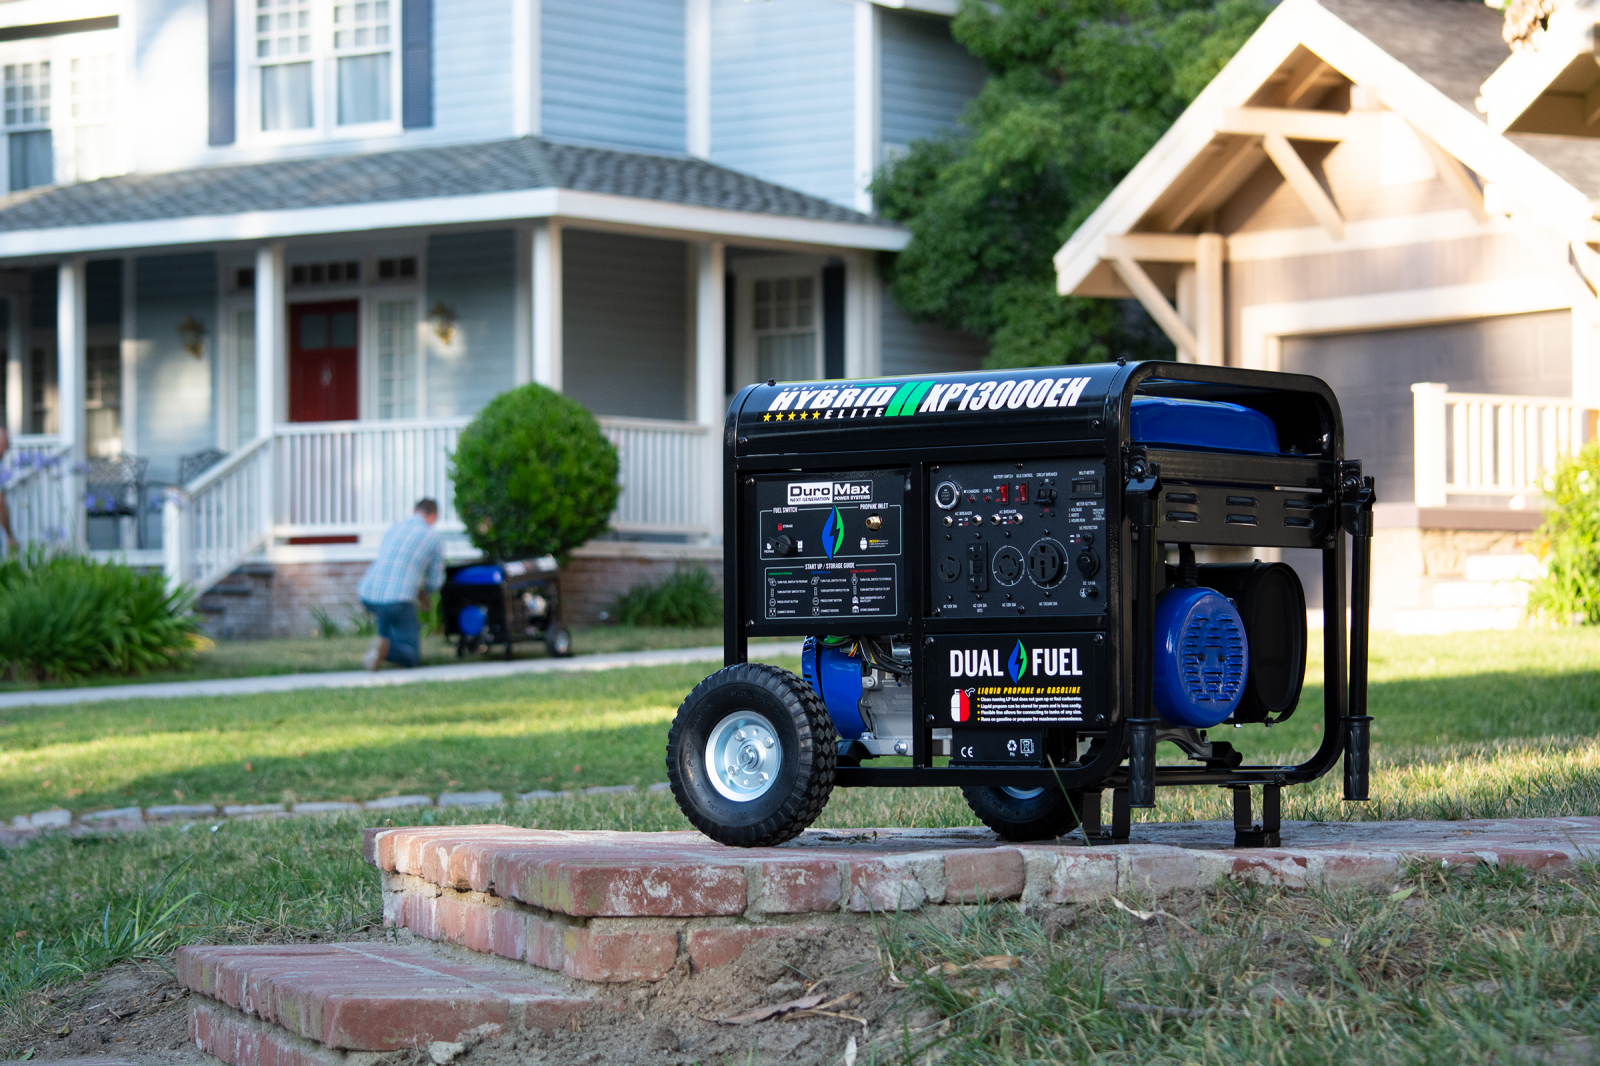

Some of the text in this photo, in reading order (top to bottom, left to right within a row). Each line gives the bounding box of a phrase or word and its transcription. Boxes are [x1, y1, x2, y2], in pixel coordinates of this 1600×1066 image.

[768, 377, 1091, 413] HYBRID XP13000EH
[824, 407, 884, 420] ELITE
[950, 648, 1083, 677] DUAL FUEL
[978, 687, 1002, 695] LIQUID
[1003, 686, 1034, 694] PROPANE
[1046, 686, 1081, 694] GASOLINE
